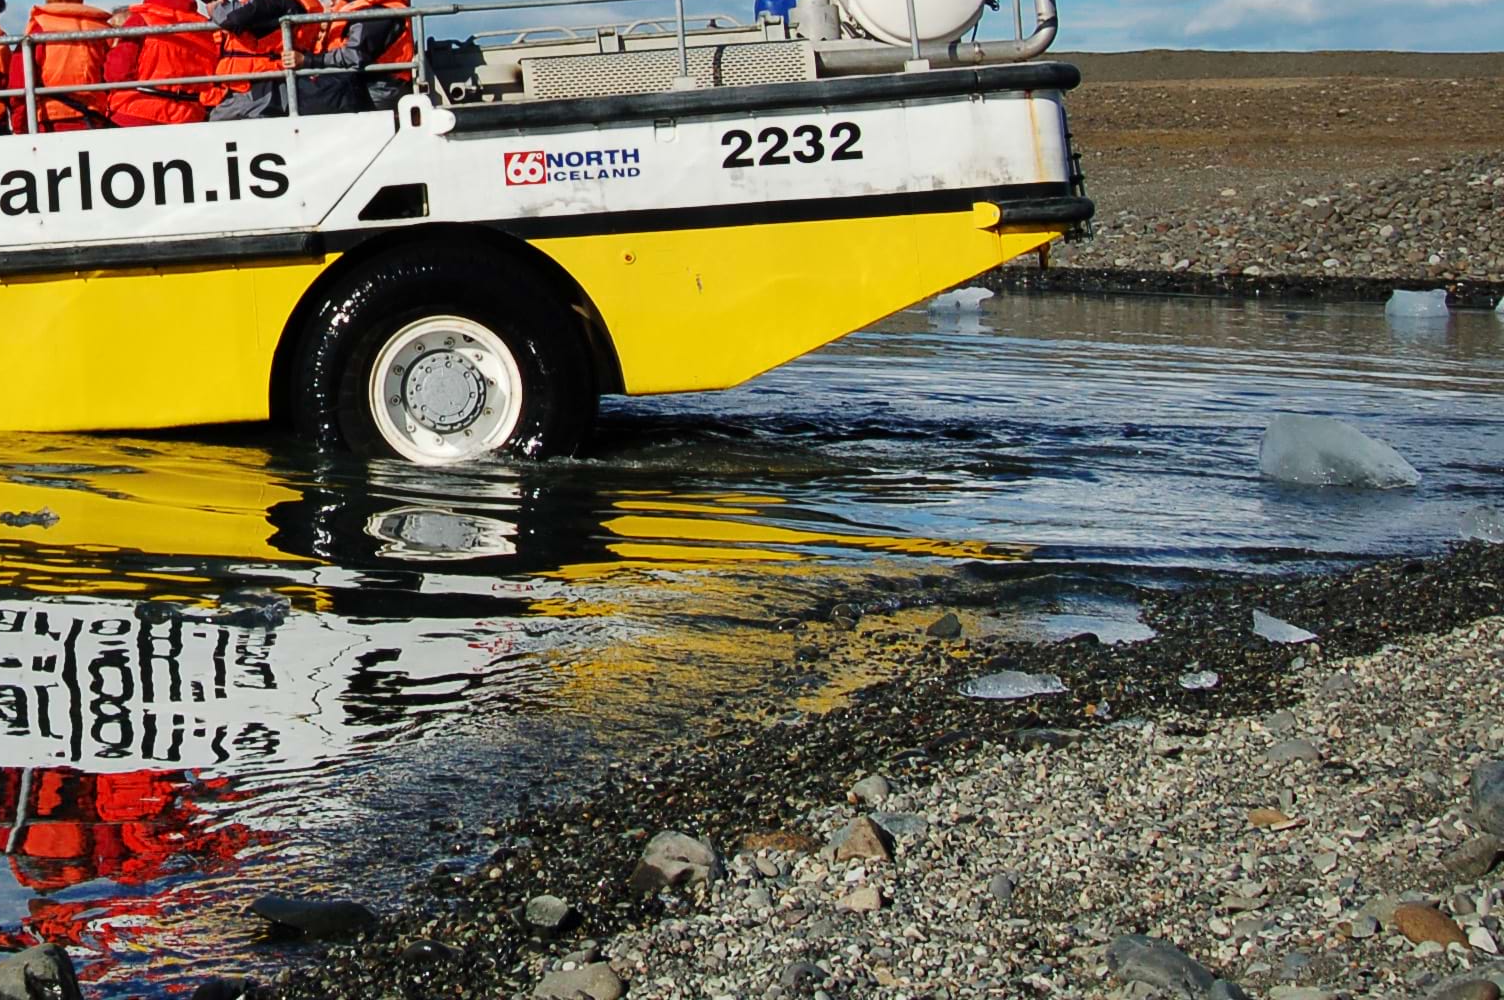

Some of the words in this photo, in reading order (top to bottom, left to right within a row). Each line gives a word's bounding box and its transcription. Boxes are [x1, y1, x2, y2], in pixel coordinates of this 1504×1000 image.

[721, 121, 864, 169] 2232
[546, 148, 640, 169] NORTH
[547, 167, 641, 182] ICELAND
